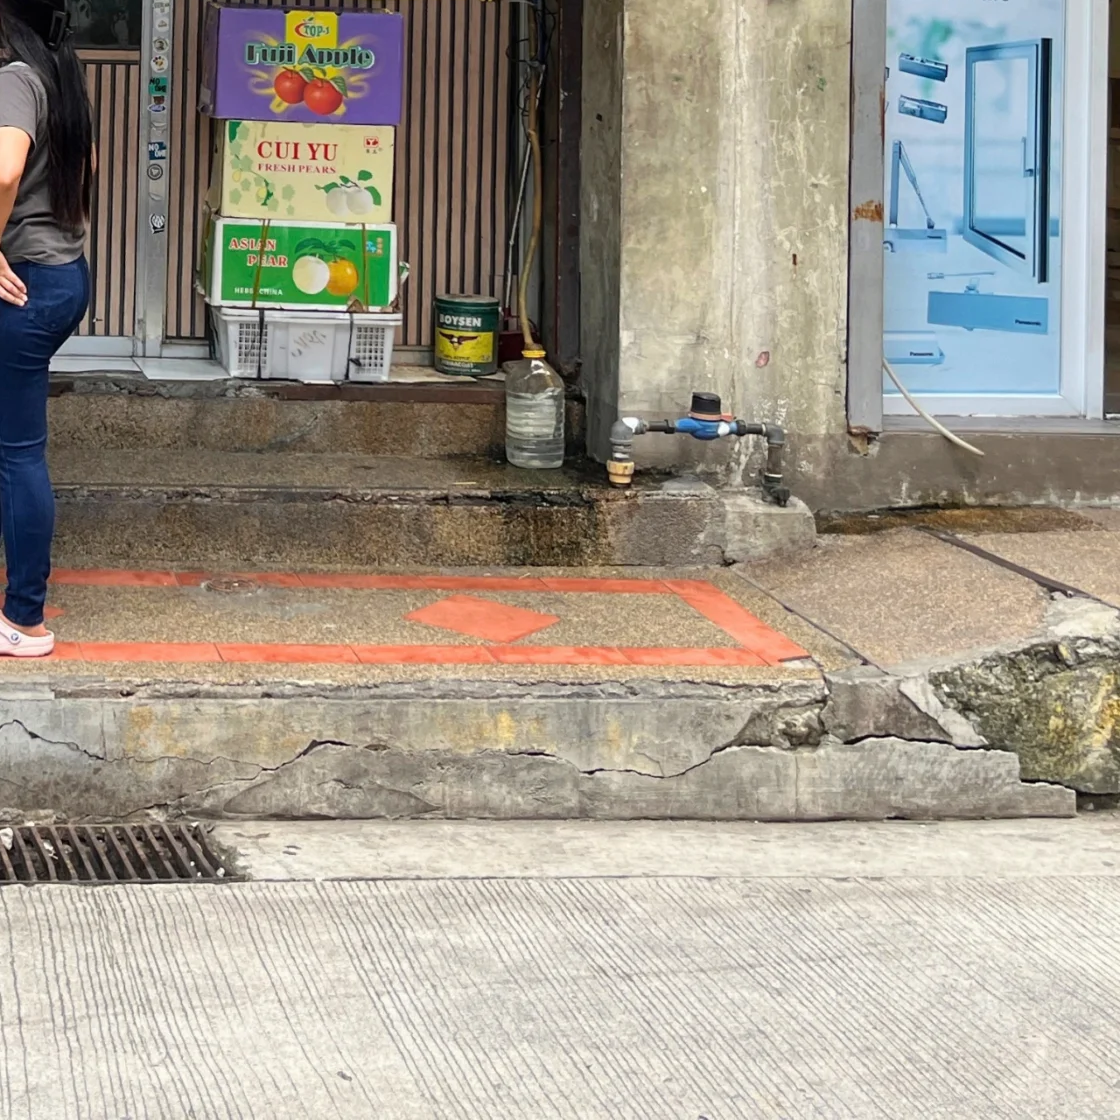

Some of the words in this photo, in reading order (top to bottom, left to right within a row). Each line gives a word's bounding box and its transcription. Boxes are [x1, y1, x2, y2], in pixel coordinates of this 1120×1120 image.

[245, 43, 295, 65] Fuji
[299, 44, 375, 68] Apple
[257, 141, 300, 160] CUI
[307, 142, 338, 161] YU
[258, 163, 295, 172] FRESH
[298, 165, 337, 174] PEARS
[228, 238, 276, 251] ASIAN
[246, 254, 288, 267] PEAR
[259, 288, 283, 296] CHINA
[439, 313, 482, 328] BOYSEN
